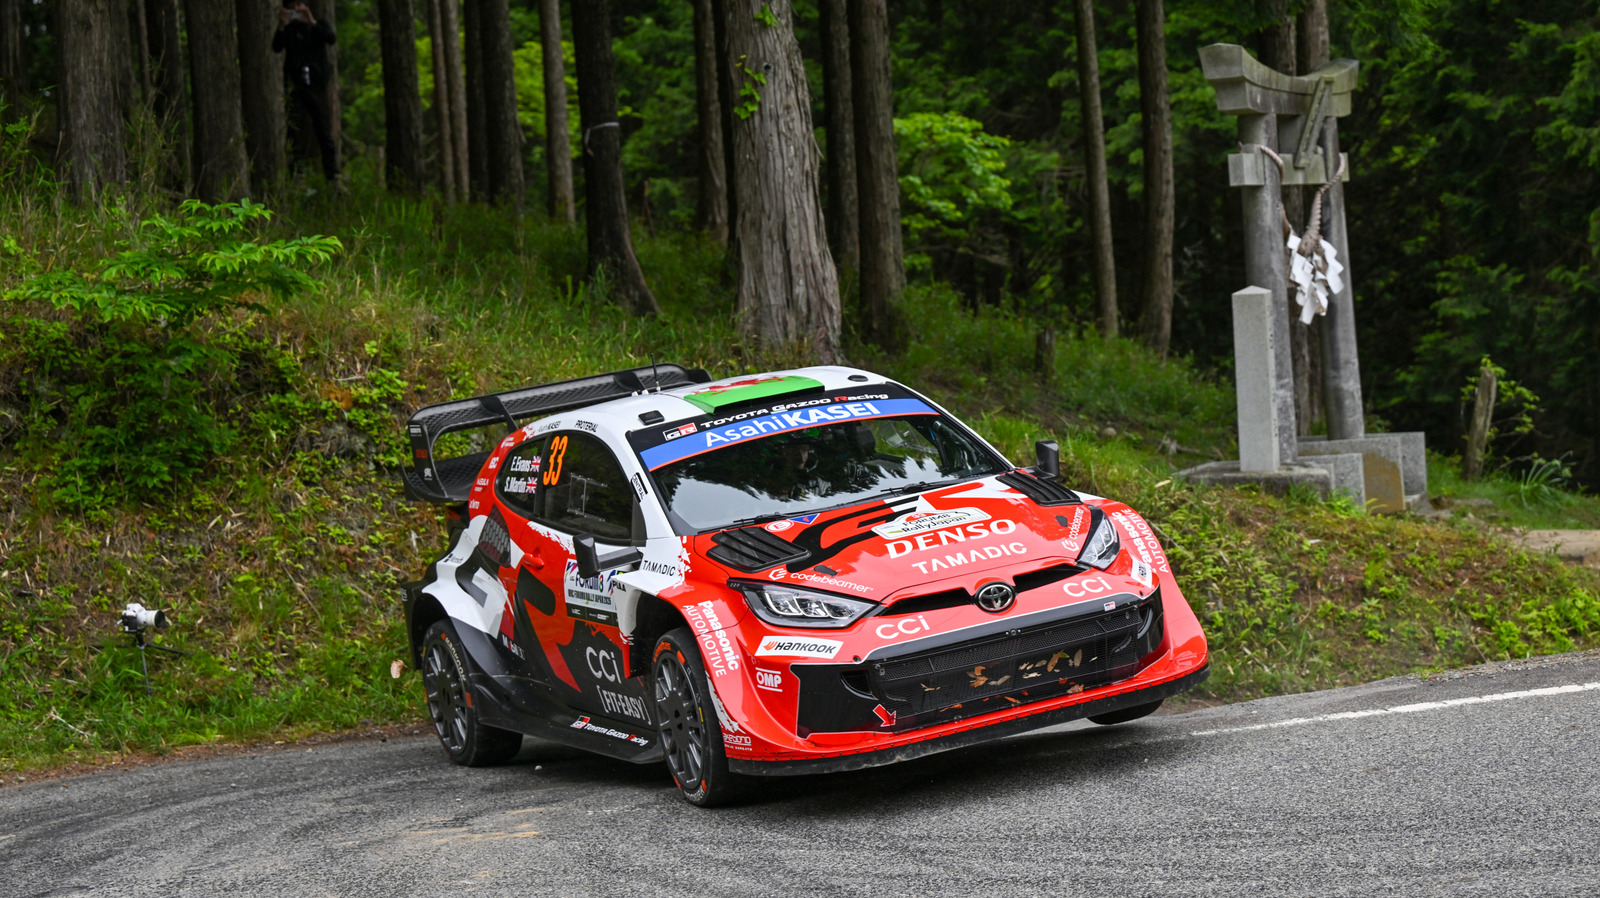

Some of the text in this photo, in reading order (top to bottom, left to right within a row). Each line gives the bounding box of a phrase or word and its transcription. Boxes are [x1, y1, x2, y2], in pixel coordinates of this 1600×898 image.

[664, 393, 889, 441] GR TOYOTA GAZOO Racing
[543, 435, 568, 486] 33
[884, 519, 1016, 559] DENSO
[912, 542, 1028, 574] TAMADIC
[1121, 508, 1168, 573] AUTOMOTIVE
[643, 560, 676, 577] TAMADIC
[790, 571, 872, 594] codebeamer
[683, 604, 727, 678] AUTOMOTIVE
[697, 599, 739, 671] Panasonic
[756, 671, 782, 688] OMP
[584, 723, 608, 735] TOYOTA
[606, 728, 630, 740] GAZOO
